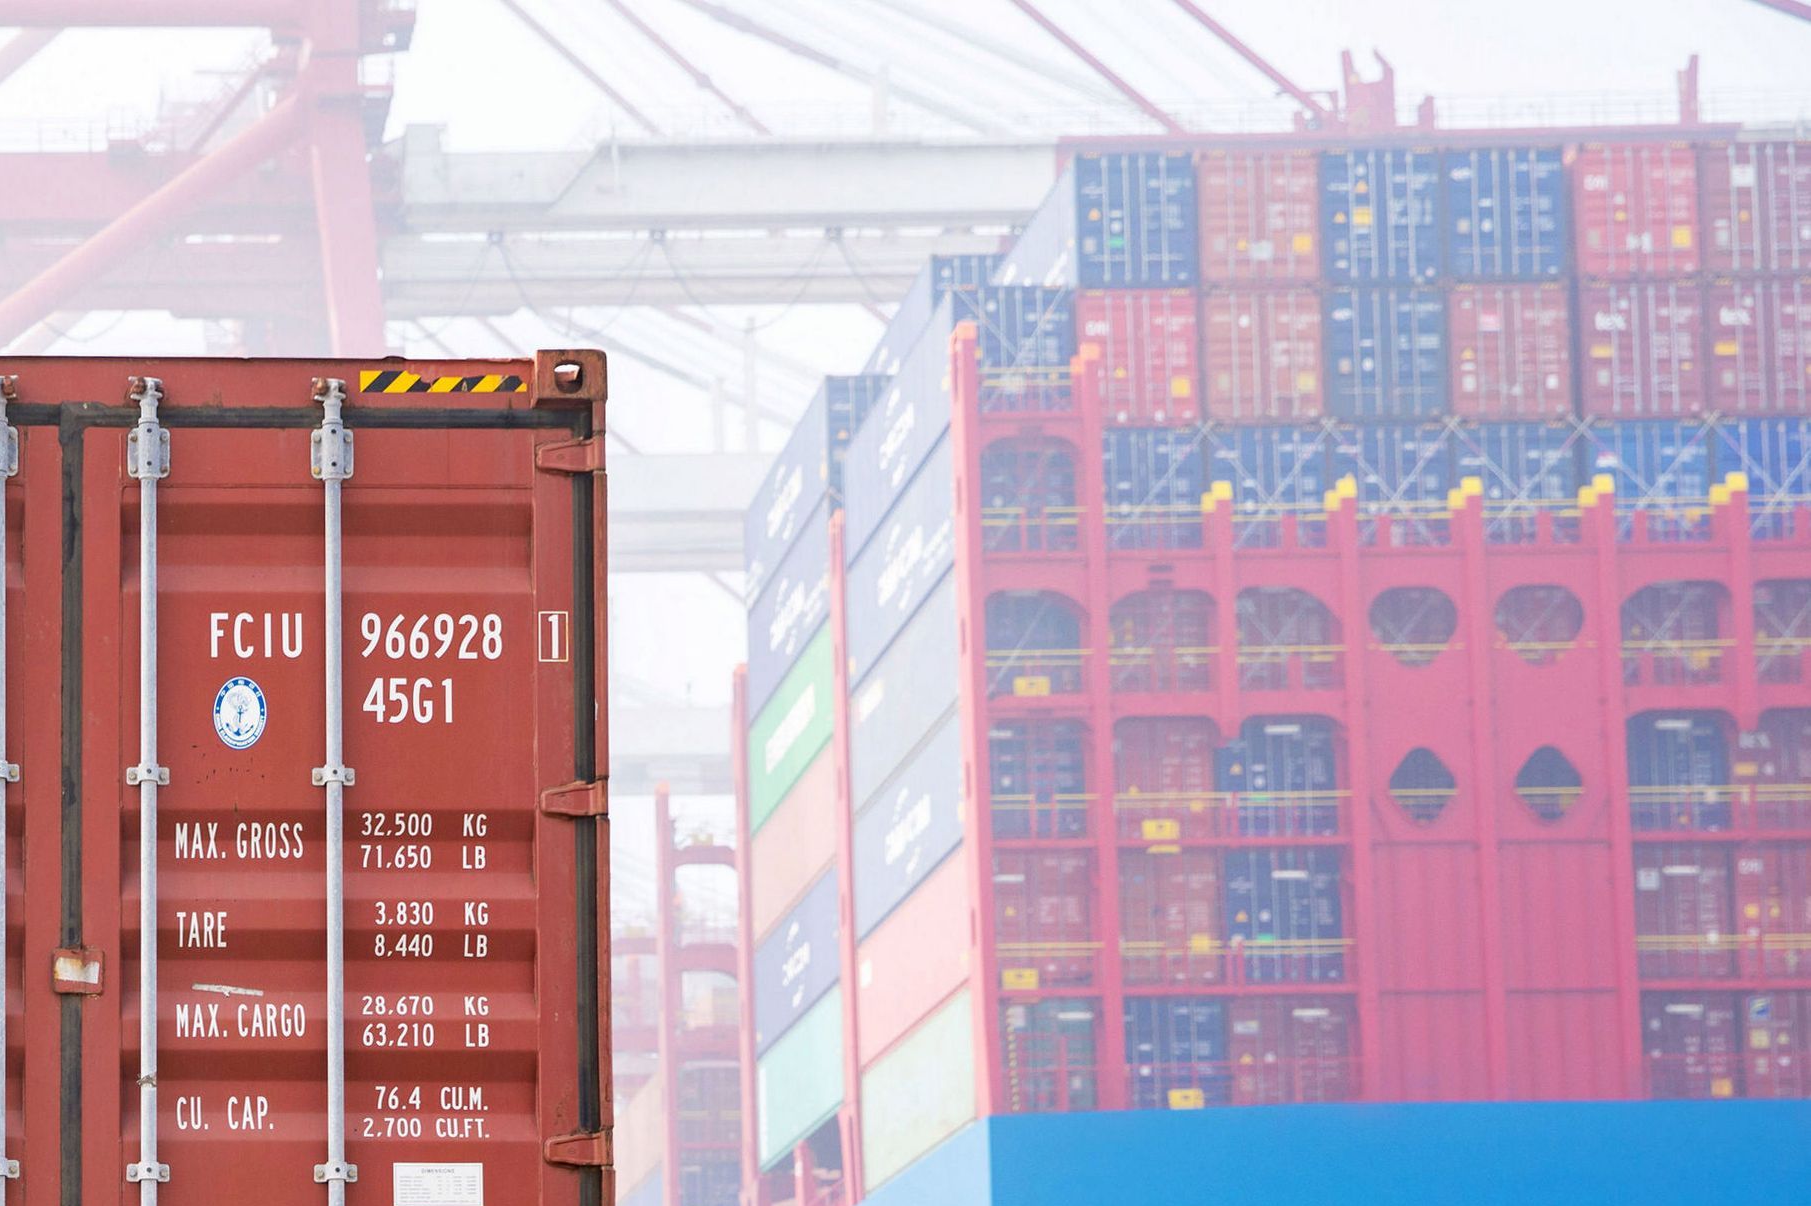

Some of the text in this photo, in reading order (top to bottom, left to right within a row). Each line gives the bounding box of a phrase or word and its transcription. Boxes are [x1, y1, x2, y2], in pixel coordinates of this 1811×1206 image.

[210, 612, 303, 659] FCIU
[360, 612, 503, 660] 966928
[361, 677, 453, 723] 45G1
[360, 812, 488, 839] 32,500 KG
[174, 821, 304, 860] MAX. GROSS
[360, 845, 487, 870] 71,650 LB
[374, 901, 489, 926] 3,830 KG
[175, 911, 228, 949] TARE
[373, 934, 488, 959] 8,440 LB
[360, 995, 490, 1017] 28,670 KG
[175, 1002, 306, 1039] MAX. CARGO
[362, 1022, 490, 1049] 63,210 LB
[374, 1086, 489, 1111] 76.4 CU.M.
[175, 1096, 274, 1131] CU. CAP.
[362, 1117, 490, 1139] 2,700 CU.FT.
